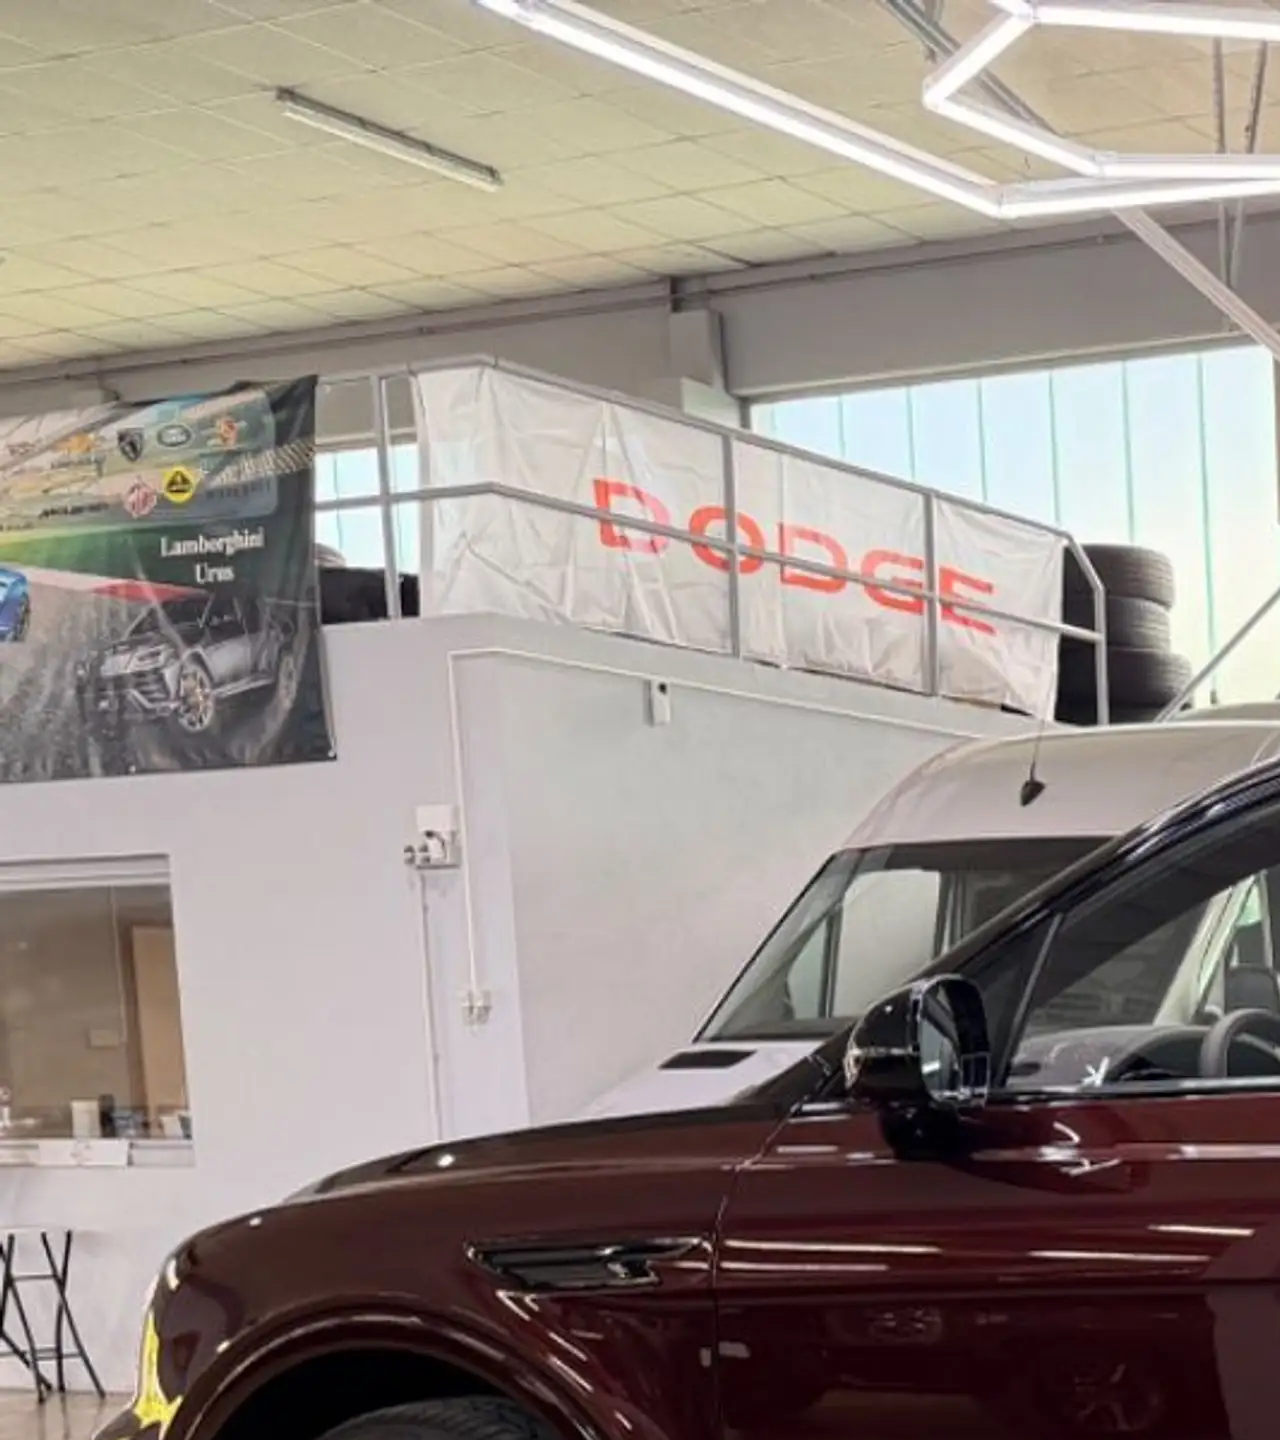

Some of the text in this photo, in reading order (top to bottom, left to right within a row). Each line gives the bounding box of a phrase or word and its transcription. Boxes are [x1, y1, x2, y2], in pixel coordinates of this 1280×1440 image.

[160, 526, 265, 557] Lamborghini
[593, 477, 998, 636] DODGE
[195, 562, 235, 584] Urus
